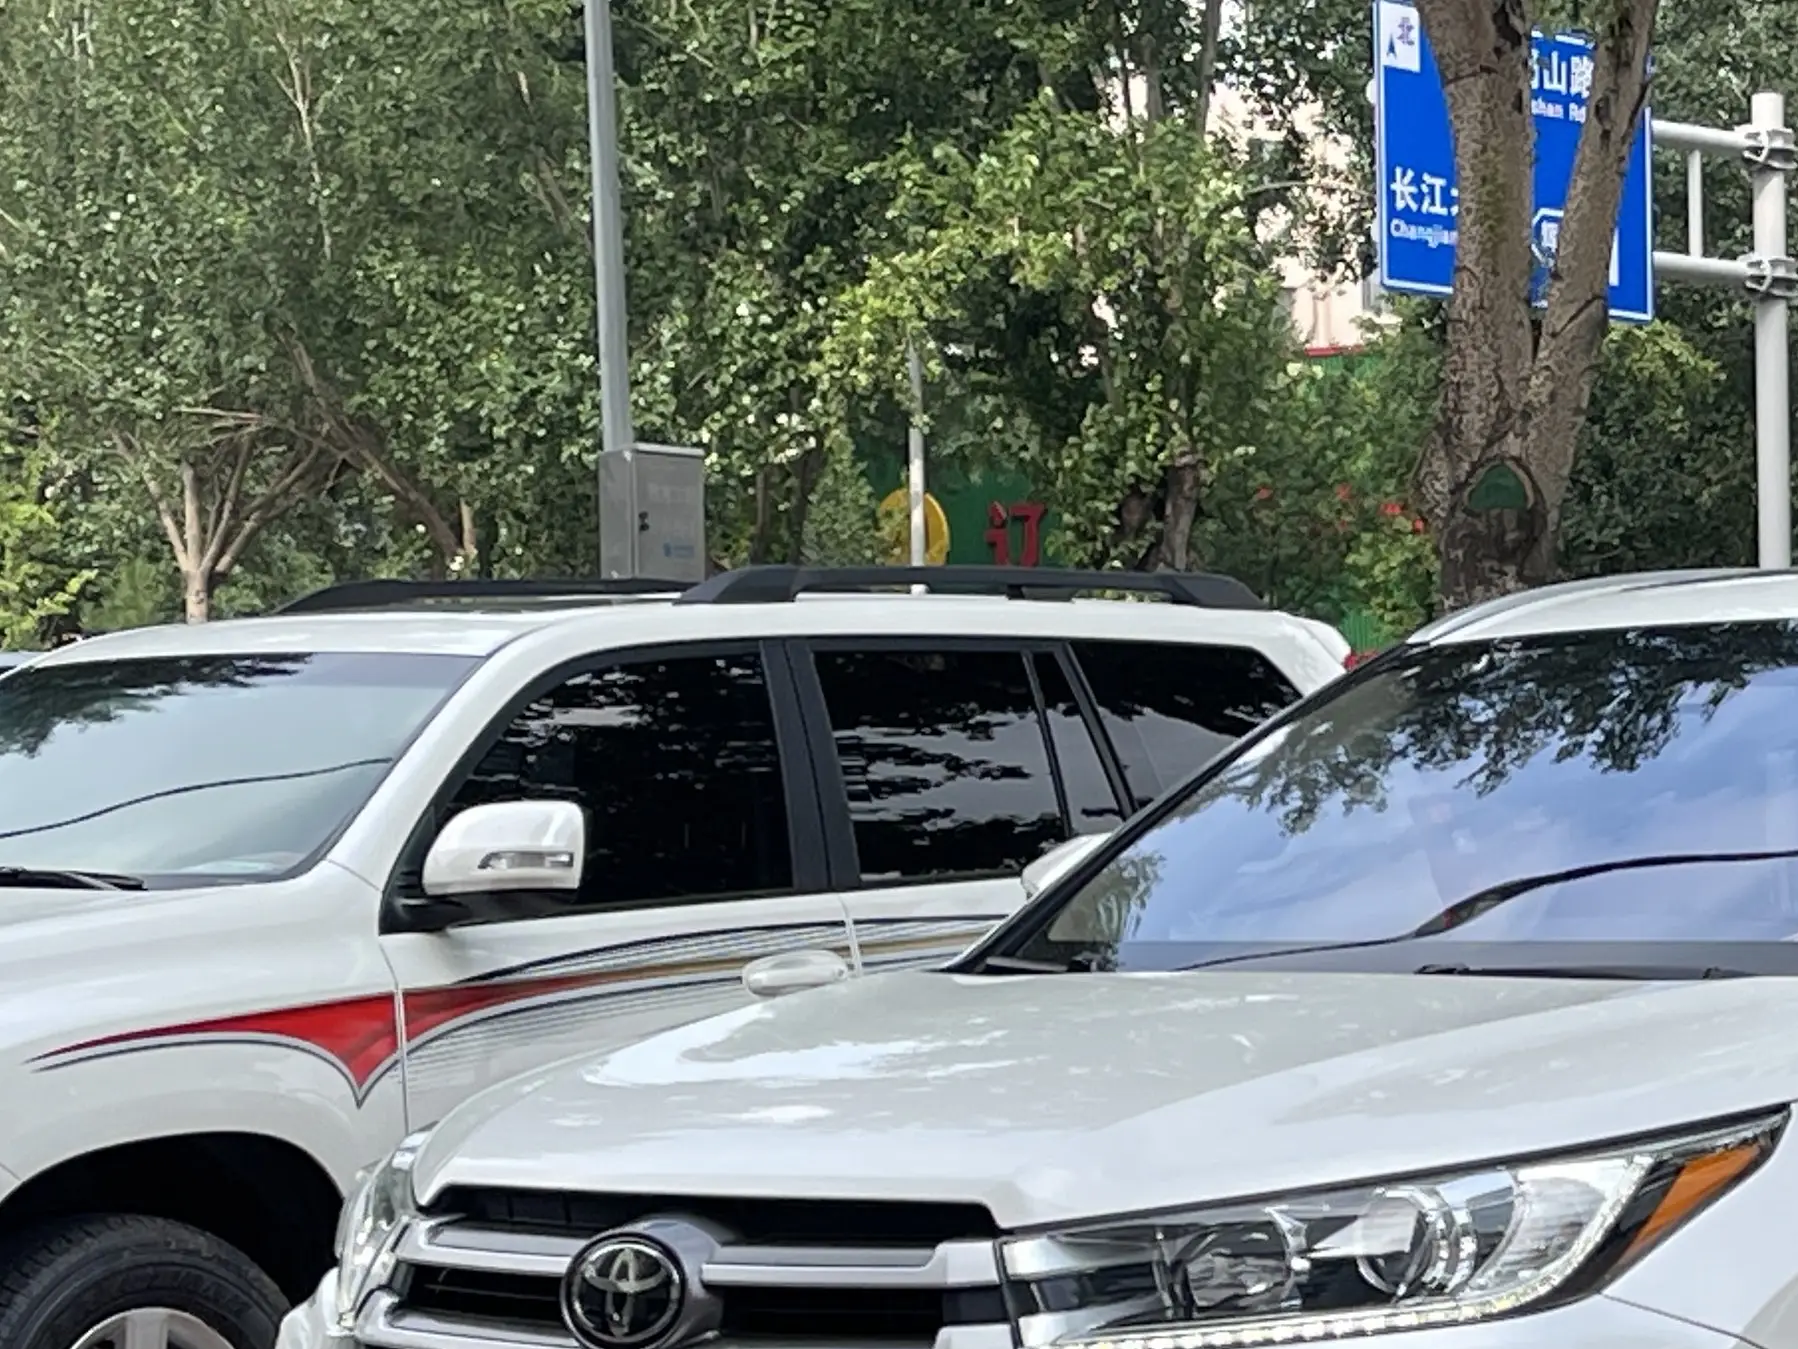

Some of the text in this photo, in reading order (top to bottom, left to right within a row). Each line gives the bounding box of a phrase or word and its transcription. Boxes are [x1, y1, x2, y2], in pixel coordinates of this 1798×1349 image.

[1397, 16, 1415, 46] 北
[1531, 97, 1564, 118] shan
[1389, 165, 1459, 217] 长江
[1389, 217, 1459, 249] Changjian
